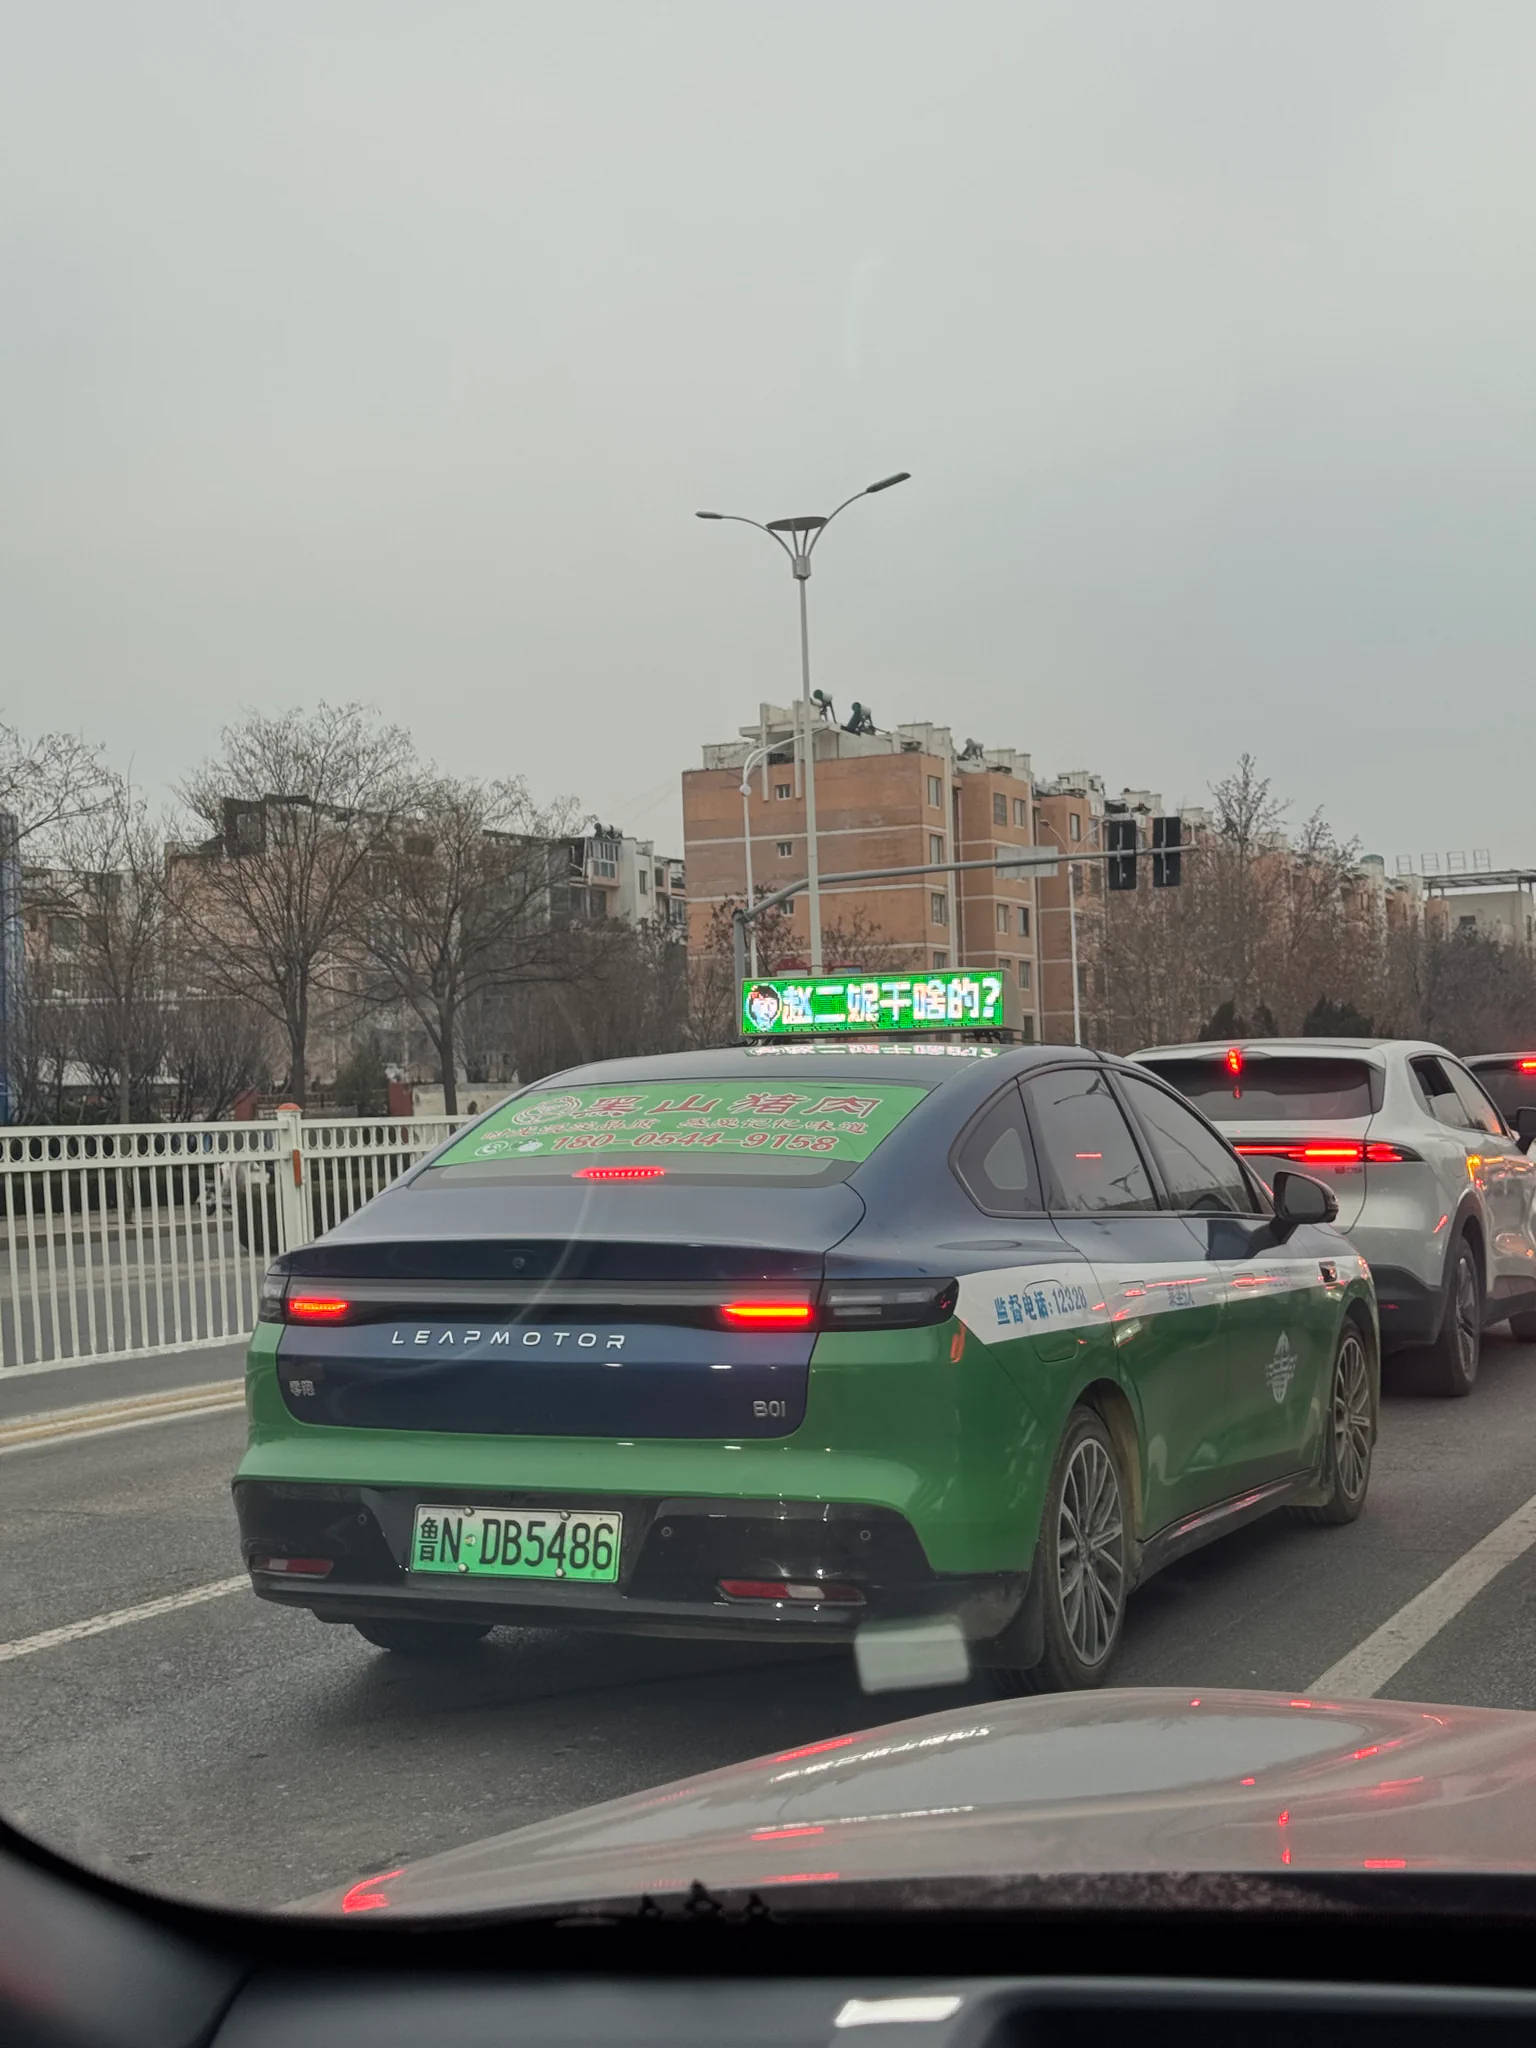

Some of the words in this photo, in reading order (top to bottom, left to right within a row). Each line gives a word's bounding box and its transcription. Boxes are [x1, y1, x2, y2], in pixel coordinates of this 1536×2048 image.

[570, 1093, 883, 1119] 黑山猪肉
[551, 1132, 839, 1152] 180-0544-9158
[994, 1285, 1087, 1325] 监督电话:12328
[391, 1330, 625, 1349] LEAPMOTOR
